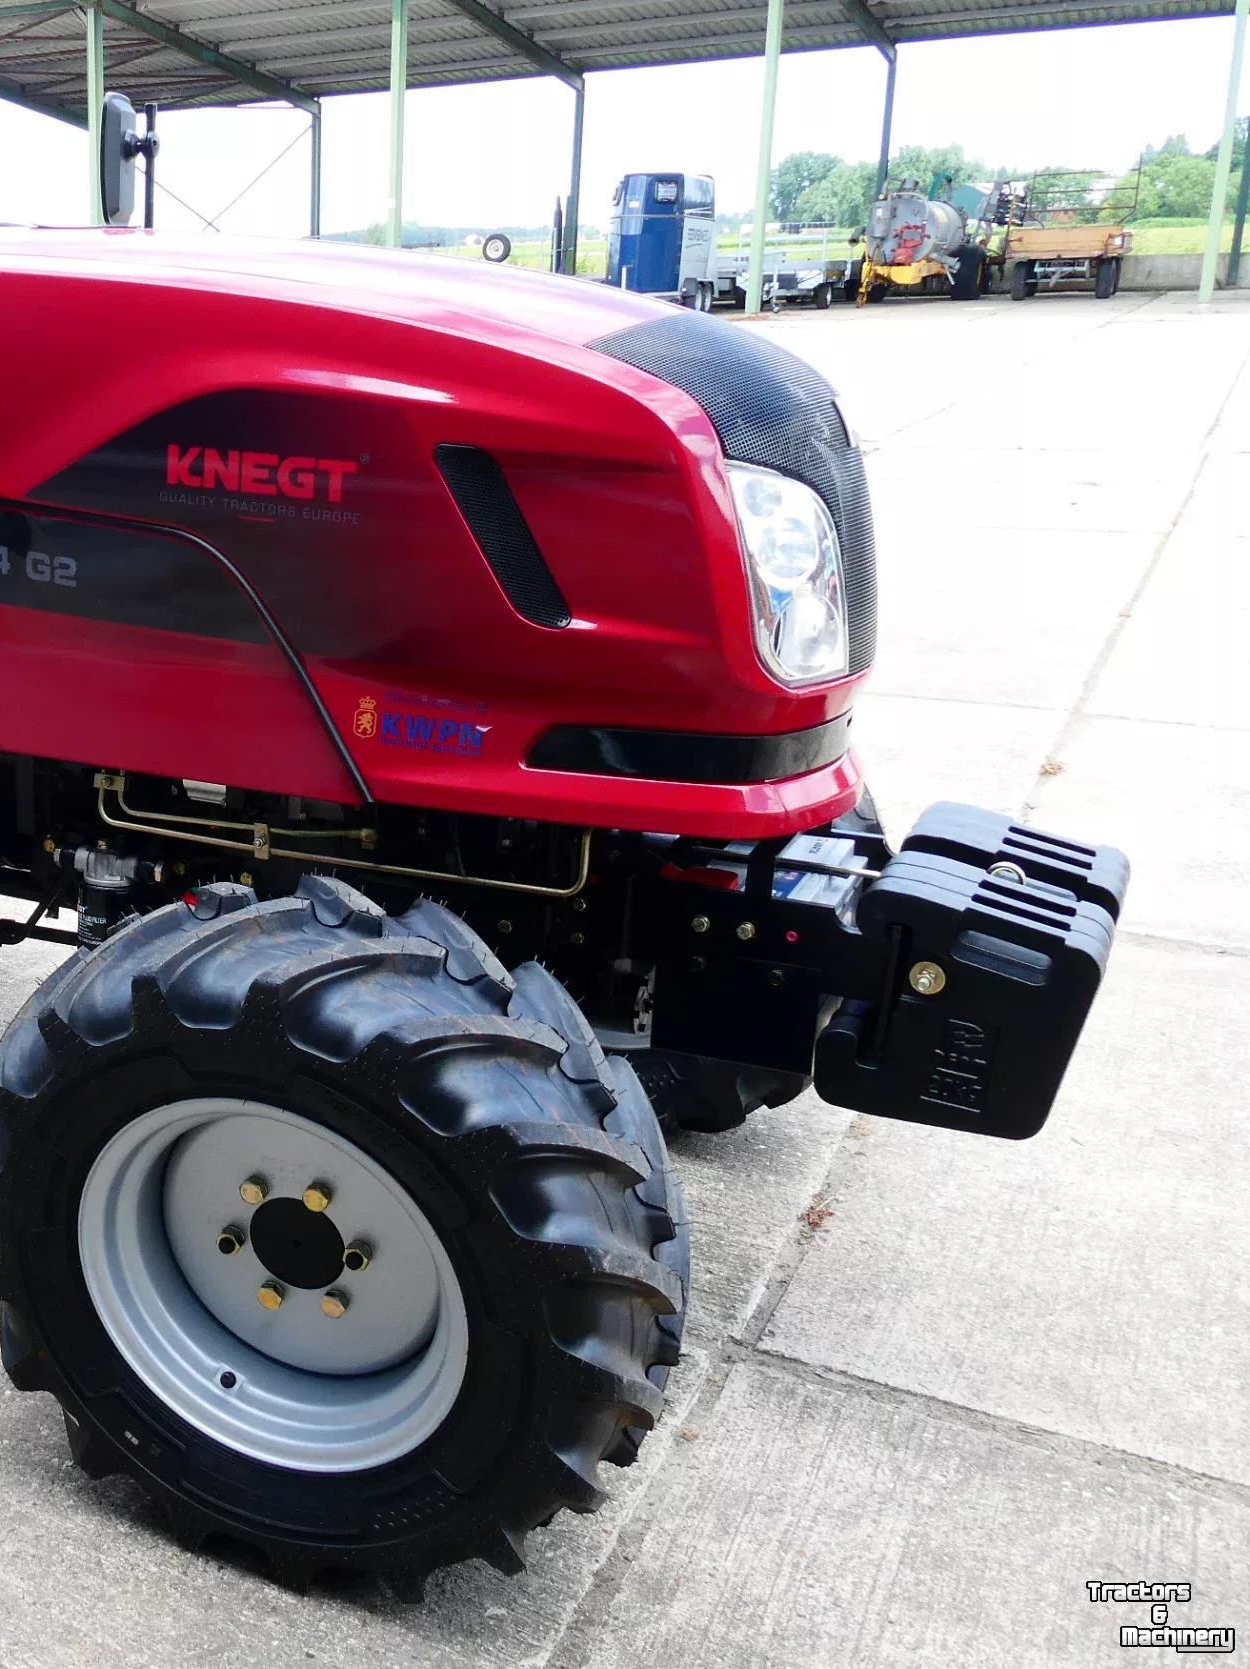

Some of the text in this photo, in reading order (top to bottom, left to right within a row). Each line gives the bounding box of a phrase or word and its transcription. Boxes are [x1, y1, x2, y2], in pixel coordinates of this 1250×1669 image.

[166, 444, 357, 503] KNEGT
[158, 489, 362, 525] QUALITY TRACTORS EUROPE
[25, 551, 78, 588] G2
[381, 712, 484, 748] KWPN
